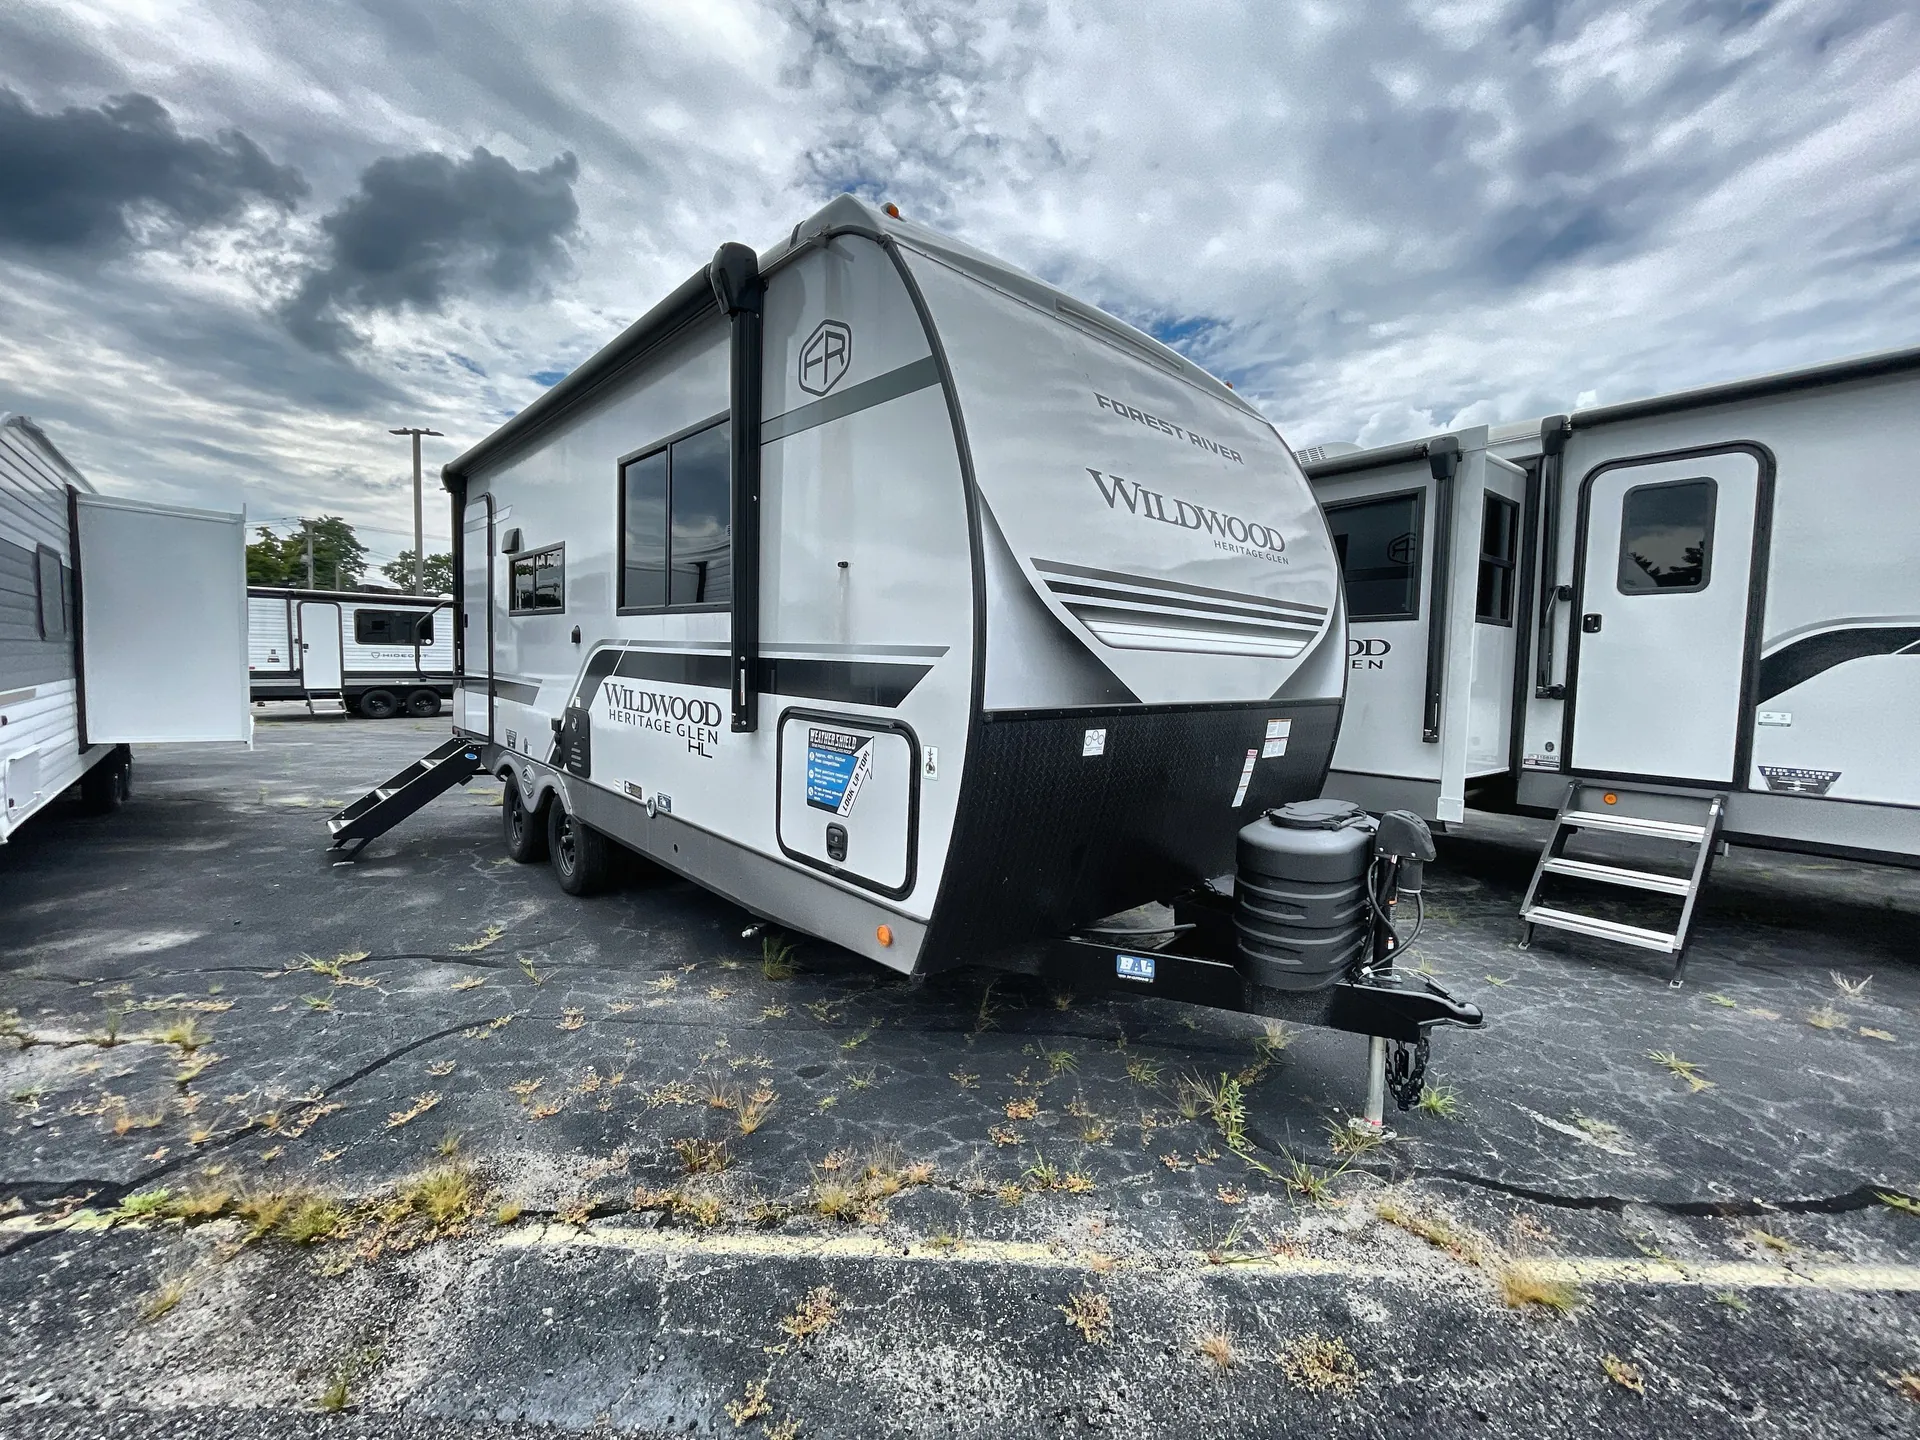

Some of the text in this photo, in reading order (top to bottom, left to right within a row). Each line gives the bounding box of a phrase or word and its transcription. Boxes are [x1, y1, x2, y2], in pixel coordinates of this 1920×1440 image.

[1093, 391, 1244, 465] FOREST RIVER
[1086, 467, 1285, 553] WILDWOOD
[1213, 540, 1289, 565] HERITAGE GLEN
[603, 682, 722, 727] WILDWOOD
[609, 708, 718, 745] HERITAGE GLEN
[688, 740, 713, 758] HL
[843, 750, 870, 812] LOOK UP TOP!
[1120, 957, 1152, 973] BAL
